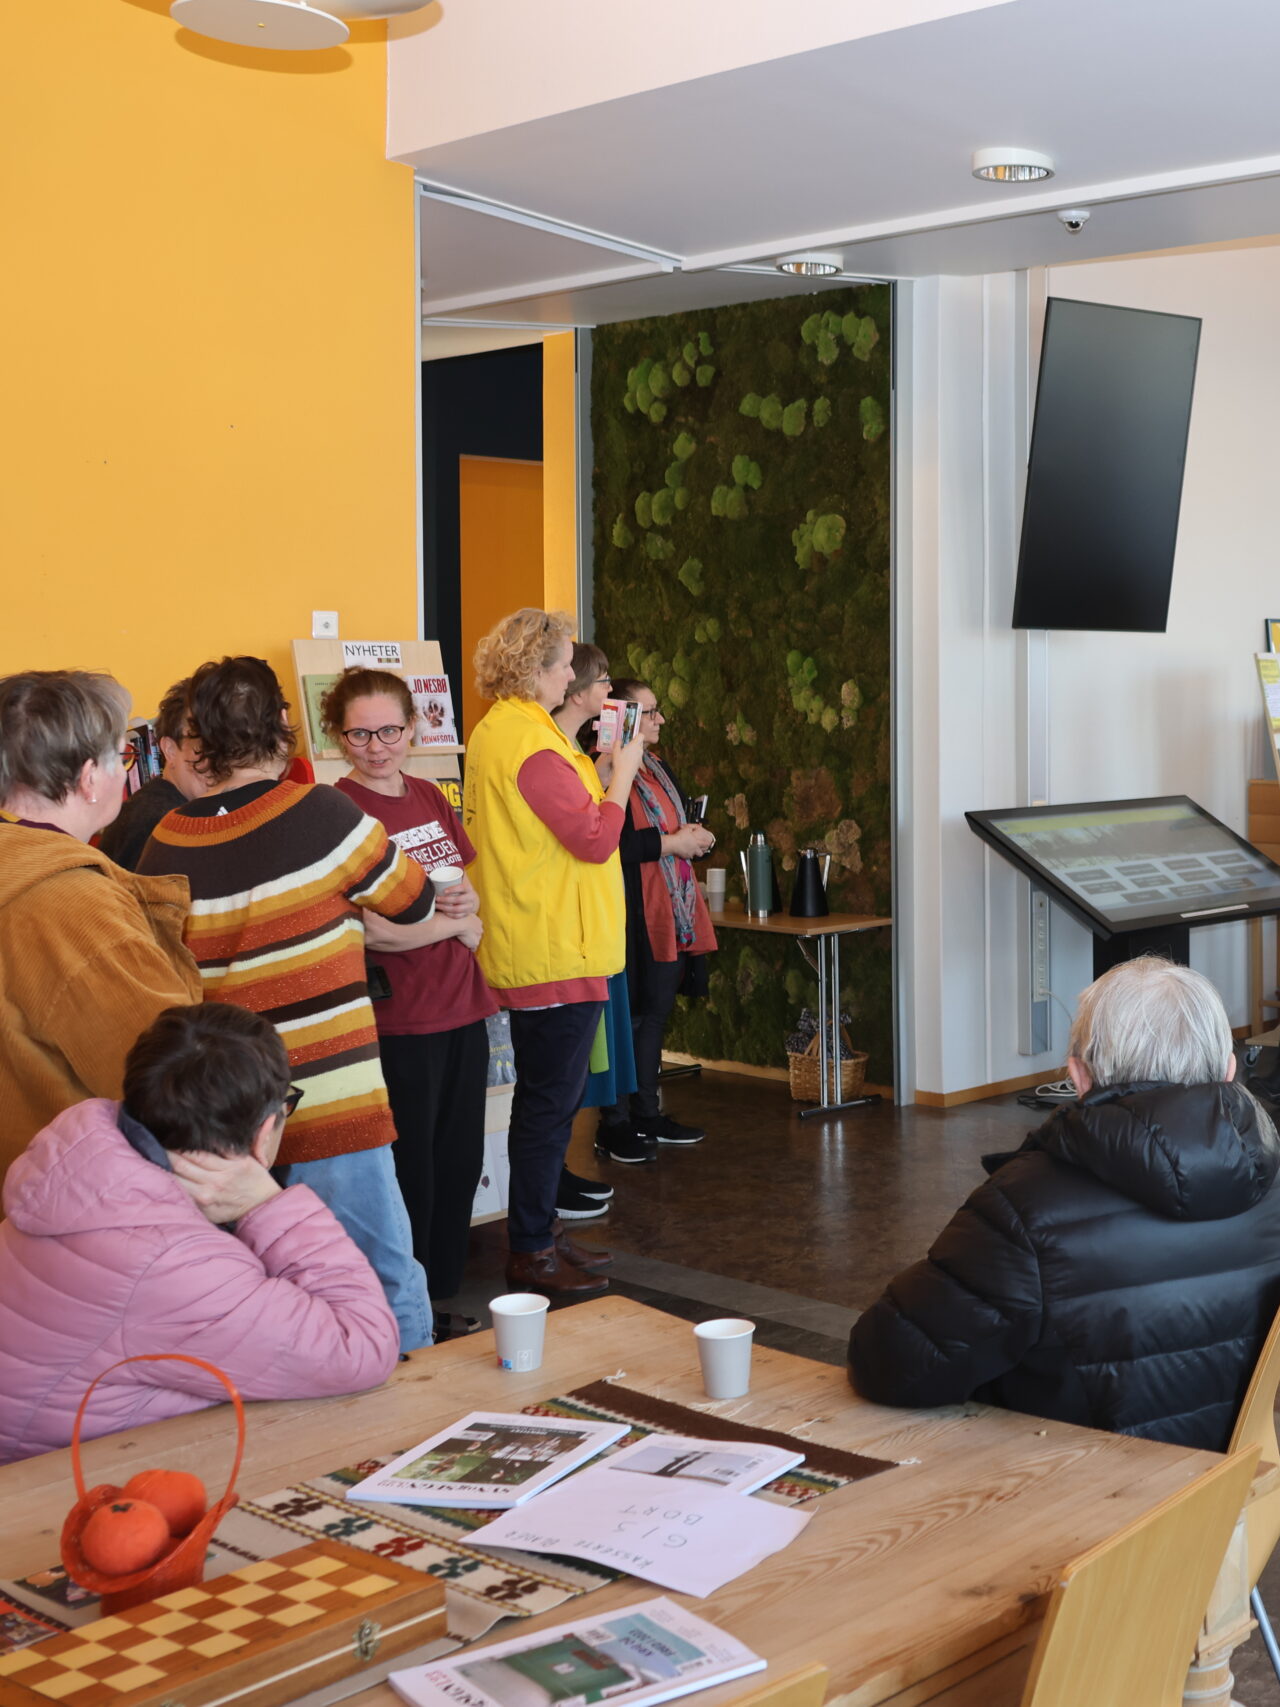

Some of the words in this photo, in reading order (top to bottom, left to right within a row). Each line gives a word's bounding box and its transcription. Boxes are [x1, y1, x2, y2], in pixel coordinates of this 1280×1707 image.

[344, 645, 399, 657] NYHETER
[412, 678, 423, 694] JO
[423, 678, 448, 694] NESBØ
[421, 734, 455, 745] MINNESOTA
[617, 1504, 703, 1526] BORT
